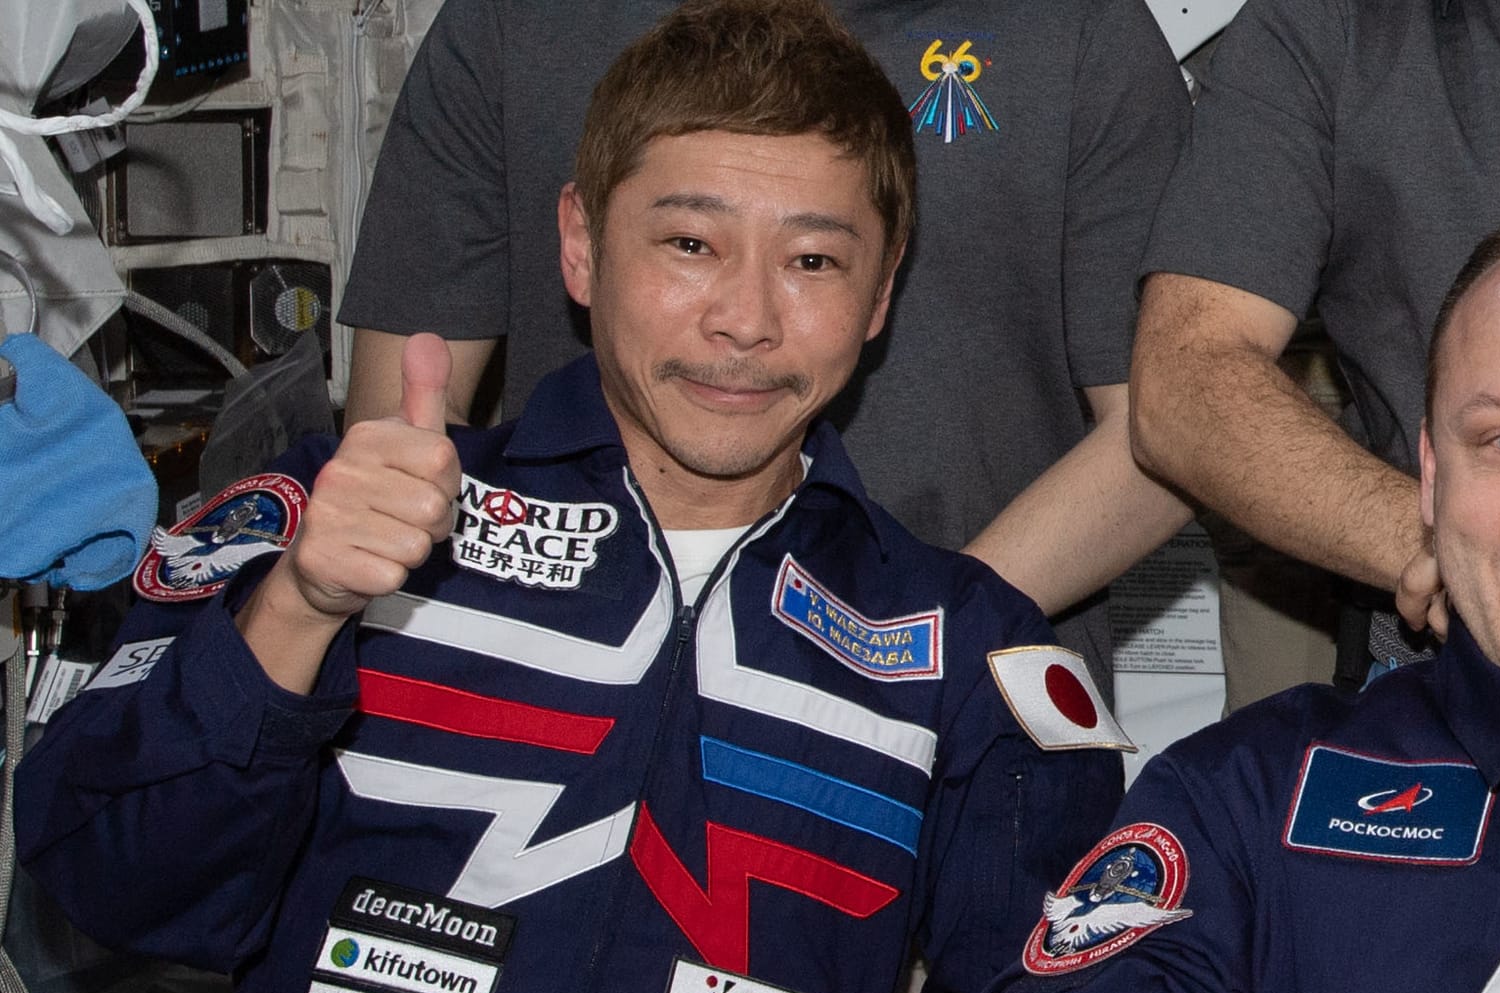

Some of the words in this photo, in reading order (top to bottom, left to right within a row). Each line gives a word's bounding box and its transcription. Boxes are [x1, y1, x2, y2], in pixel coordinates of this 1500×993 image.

[920, 39, 982, 82] 66
[454, 509, 589, 562] PEACE
[459, 540, 574, 583] 世界平和
[825, 604, 913, 646] MAEZAWA
[1328, 818, 1445, 840] РОСКОСМОС
[352, 888, 498, 947] dearMoon
